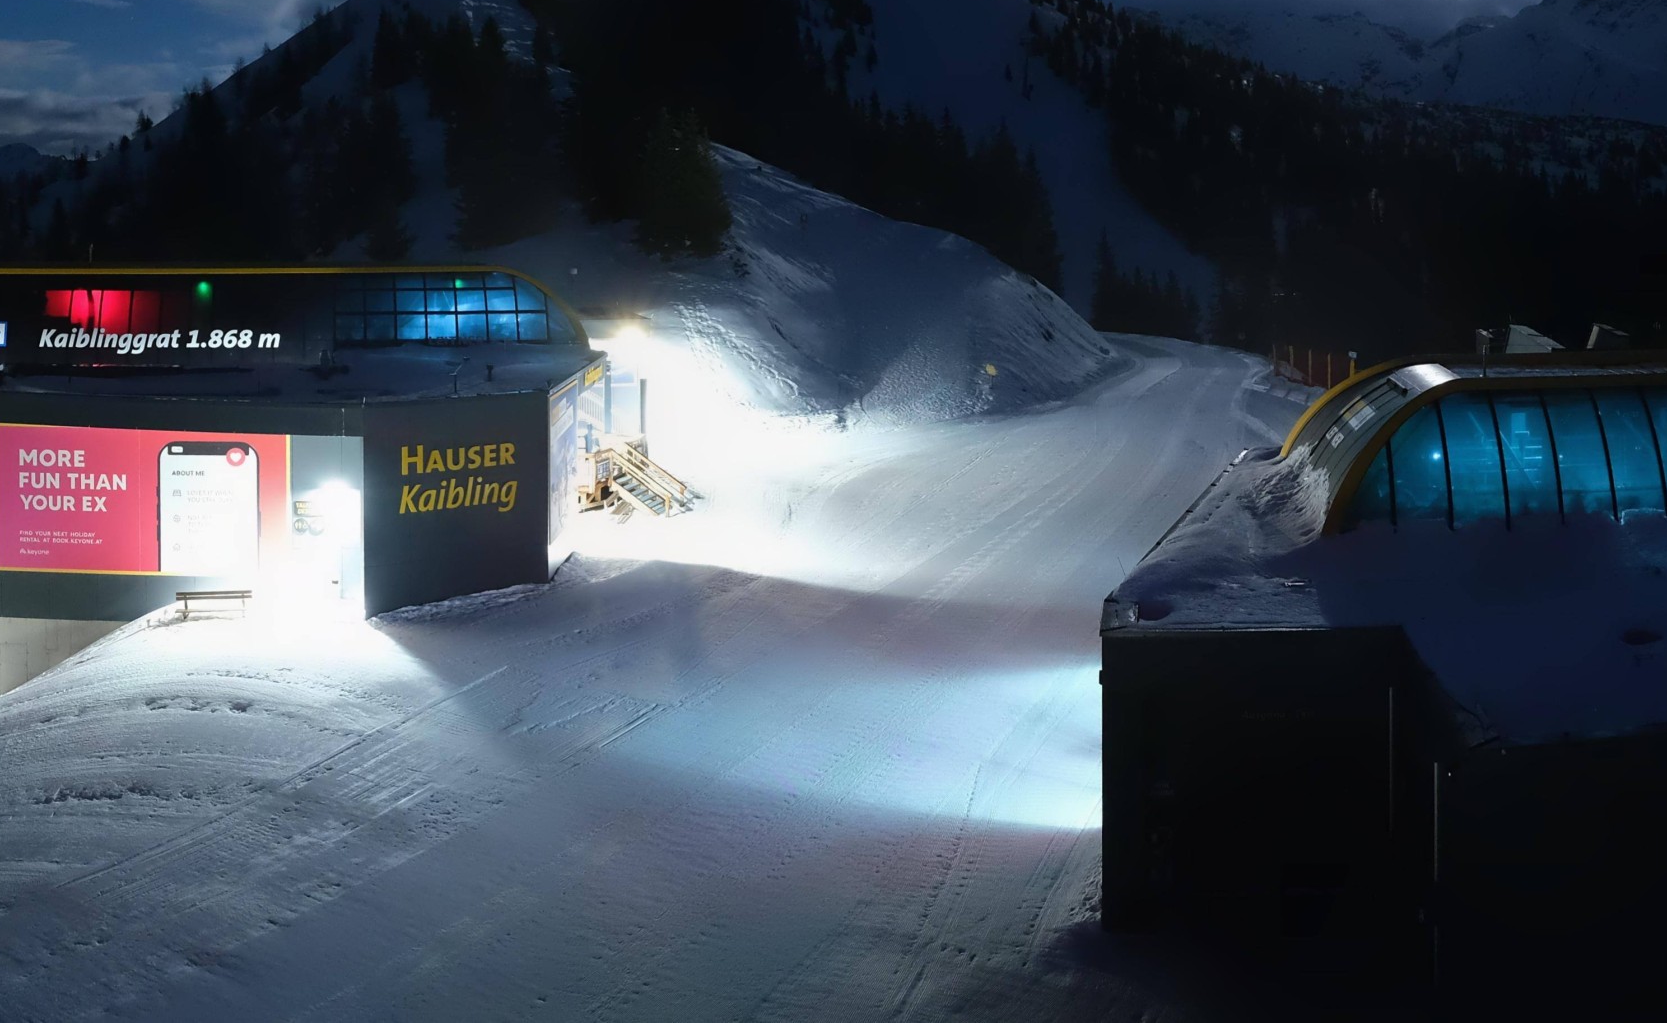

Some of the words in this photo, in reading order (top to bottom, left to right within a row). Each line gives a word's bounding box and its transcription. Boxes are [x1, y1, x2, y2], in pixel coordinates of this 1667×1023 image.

[39, 329, 181, 355] Kaiblinggrat
[186, 329, 253, 348] 1.868
[258, 333, 281, 348] m
[19, 449, 85, 467] MORE
[401, 443, 516, 475] HAUSER
[19, 472, 60, 489] FUN
[67, 473, 127, 490] THAN
[20, 495, 76, 511] YOUR
[82, 496, 107, 512] EX
[399, 476, 518, 514] Kaibling
